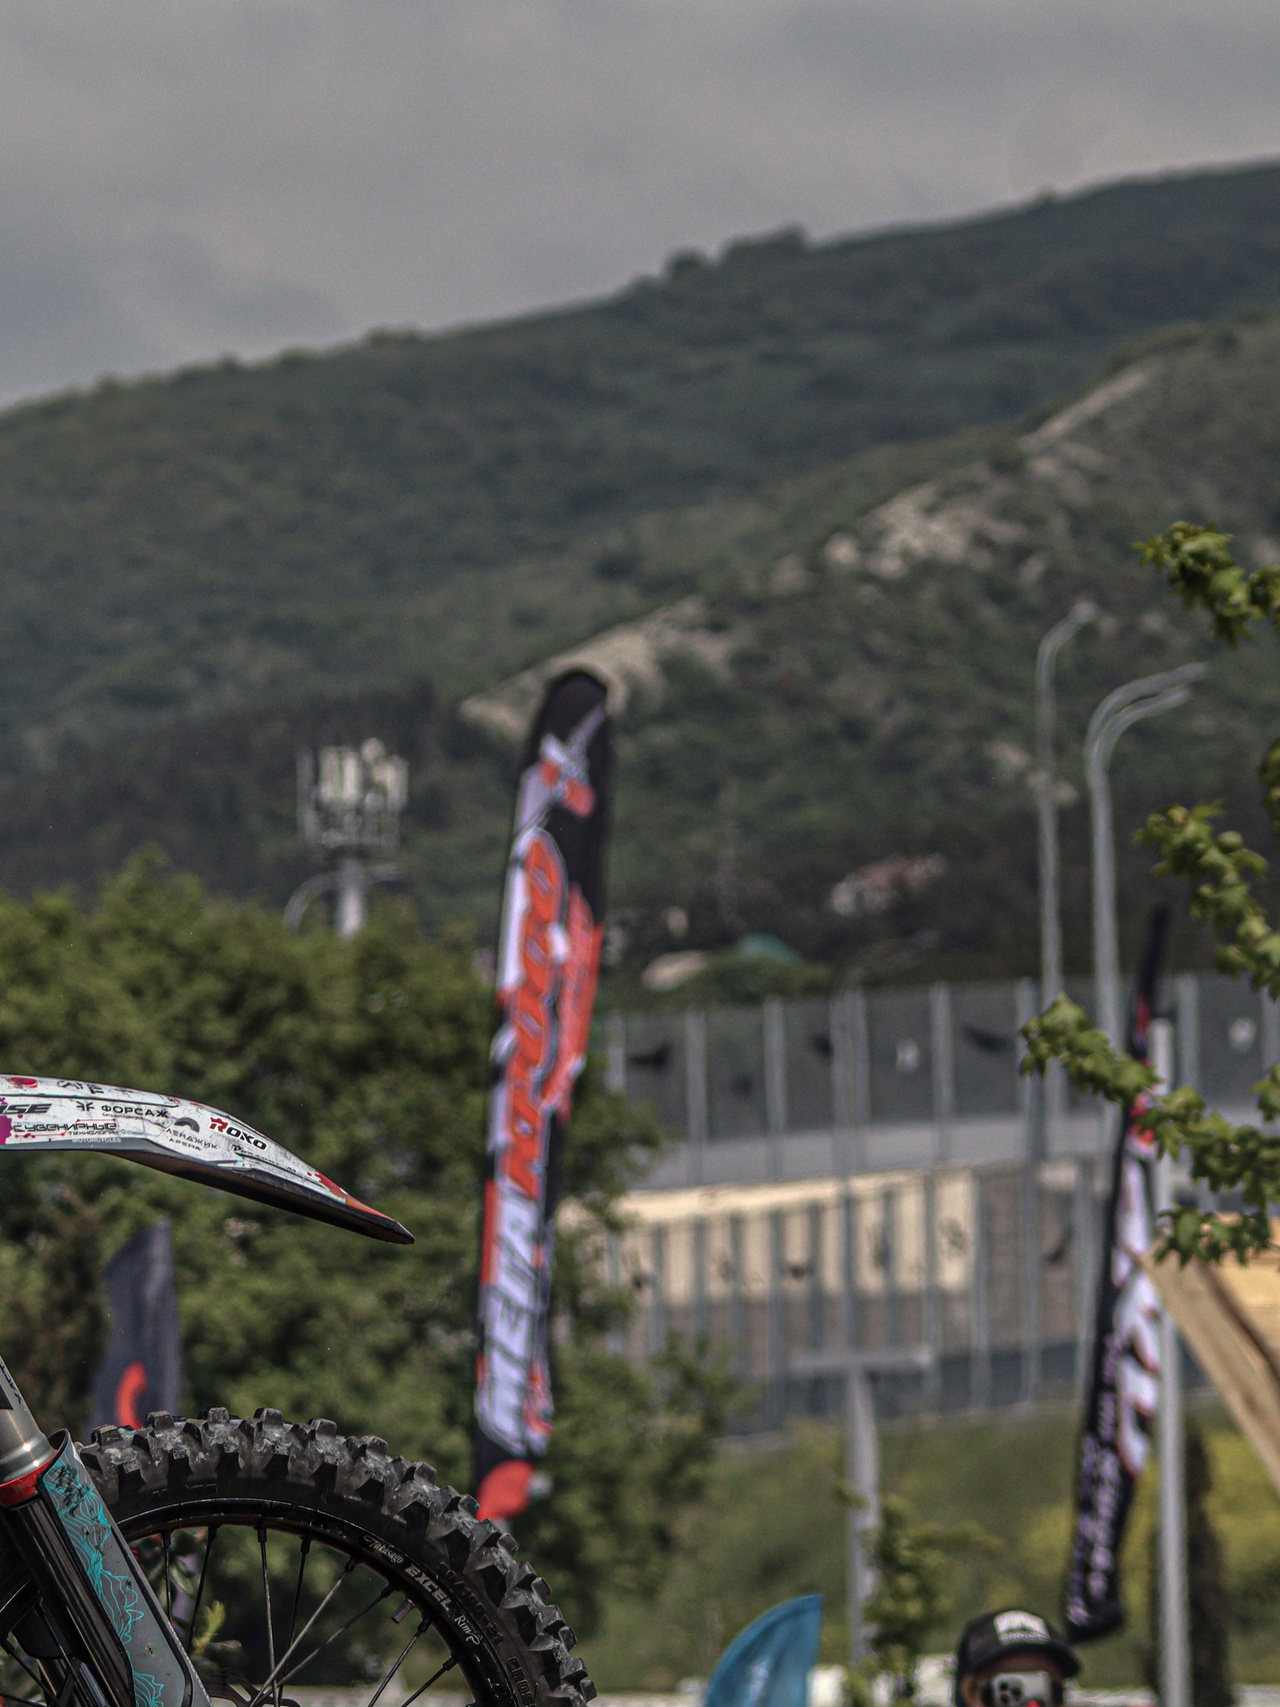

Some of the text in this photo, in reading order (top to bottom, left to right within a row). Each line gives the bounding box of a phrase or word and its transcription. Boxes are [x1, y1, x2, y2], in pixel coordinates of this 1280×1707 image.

[101, 1104, 169, 1119] ФОРСАЖ
[404, 1563, 455, 1613] EXCEL
[506, 1655, 538, 1707] CROS
